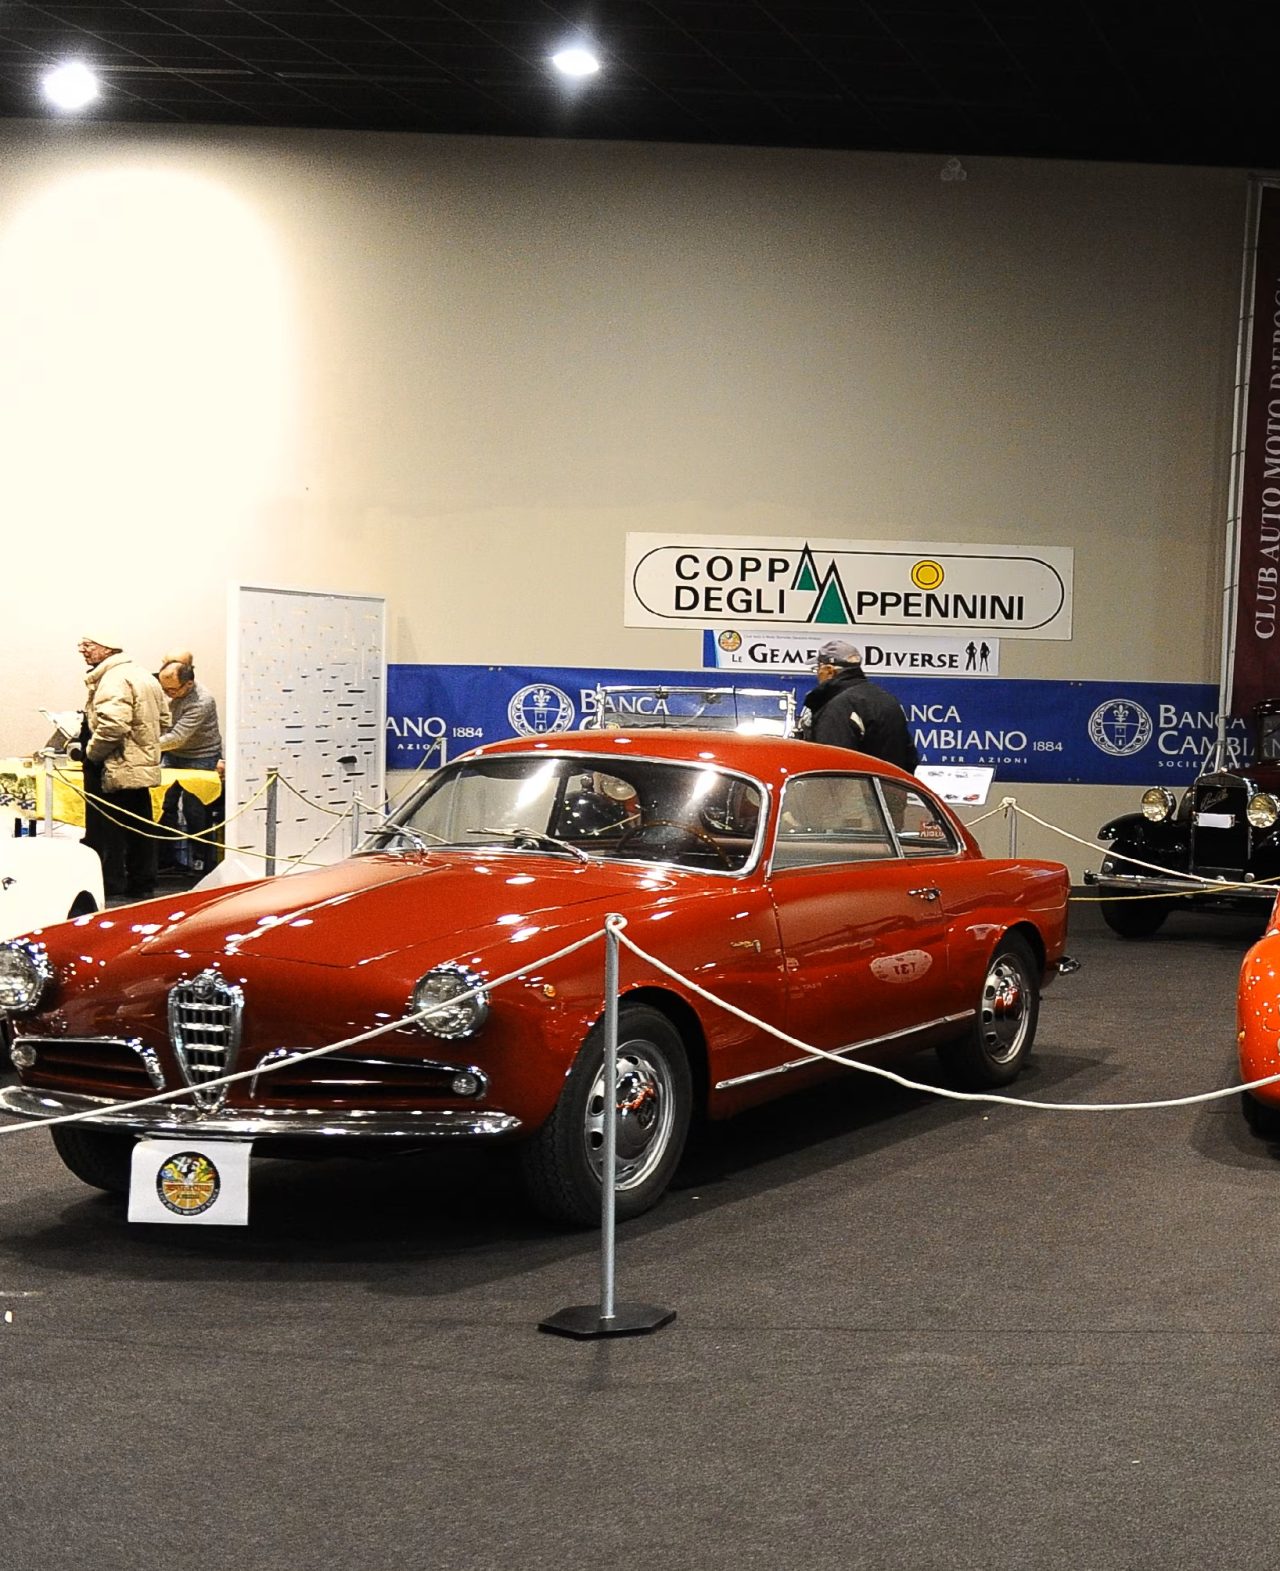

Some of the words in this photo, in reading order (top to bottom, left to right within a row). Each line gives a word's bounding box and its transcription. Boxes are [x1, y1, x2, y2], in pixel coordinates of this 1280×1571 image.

[674, 585, 786, 615] DEGLI
[1255, 566, 1279, 639] CLUB
[748, 643, 817, 664] GEME
[865, 646, 960, 669] DIVERSE
[900, 704, 962, 723] NCA
[452, 727, 484, 738] 1884
[914, 729, 1027, 751] MBIANO
[1033, 741, 1064, 752] 1884
[397, 743, 442, 751] AZIO
[979, 756, 1028, 764] AZIONI
